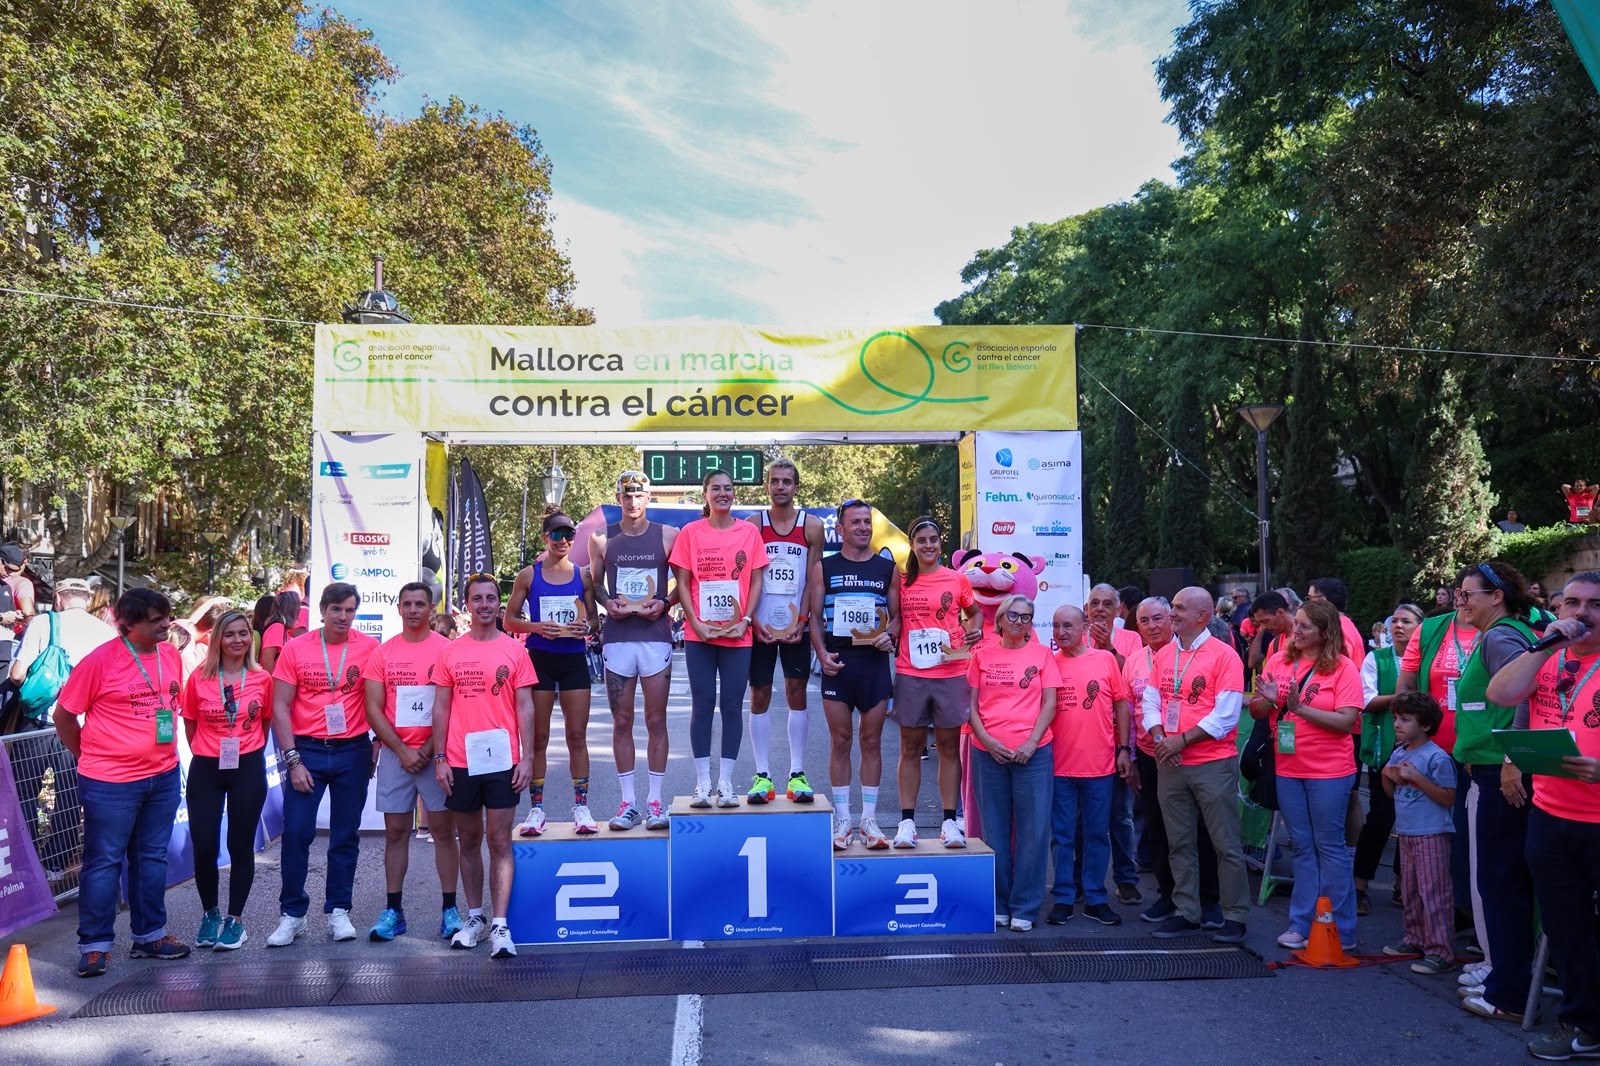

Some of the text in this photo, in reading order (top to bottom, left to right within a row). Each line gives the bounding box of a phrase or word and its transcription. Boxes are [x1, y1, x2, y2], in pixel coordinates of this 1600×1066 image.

[1020, 344, 1056, 352] española
[490, 346, 794, 372] Mallorca en marcha
[989, 362, 1004, 370] Illes
[1006, 362, 1037, 370] Balears
[489, 387, 794, 417] contra el cáncer
[985, 492, 1022, 502] Fehm.
[993, 524, 1015, 533] Quely
[352, 534, 388, 544] EROSKI
[788, 546, 802, 556] EAD
[354, 568, 398, 578] SAMPOL
[768, 568, 794, 580] 1553
[624, 581, 649, 594] 1874
[706, 594, 733, 608] 1339
[548, 610, 576, 623] 1179
[842, 610, 868, 624] 1980
[916, 640, 944, 656] 1181
[1538, 684, 1549, 692] En
[412, 702, 424, 712] 44
[486, 747, 492, 758] 1
[738, 836, 768, 918] 1
[4, 882, 24, 896] Palma
[555, 862, 620, 920] 2
[895, 874, 938, 914] 3
